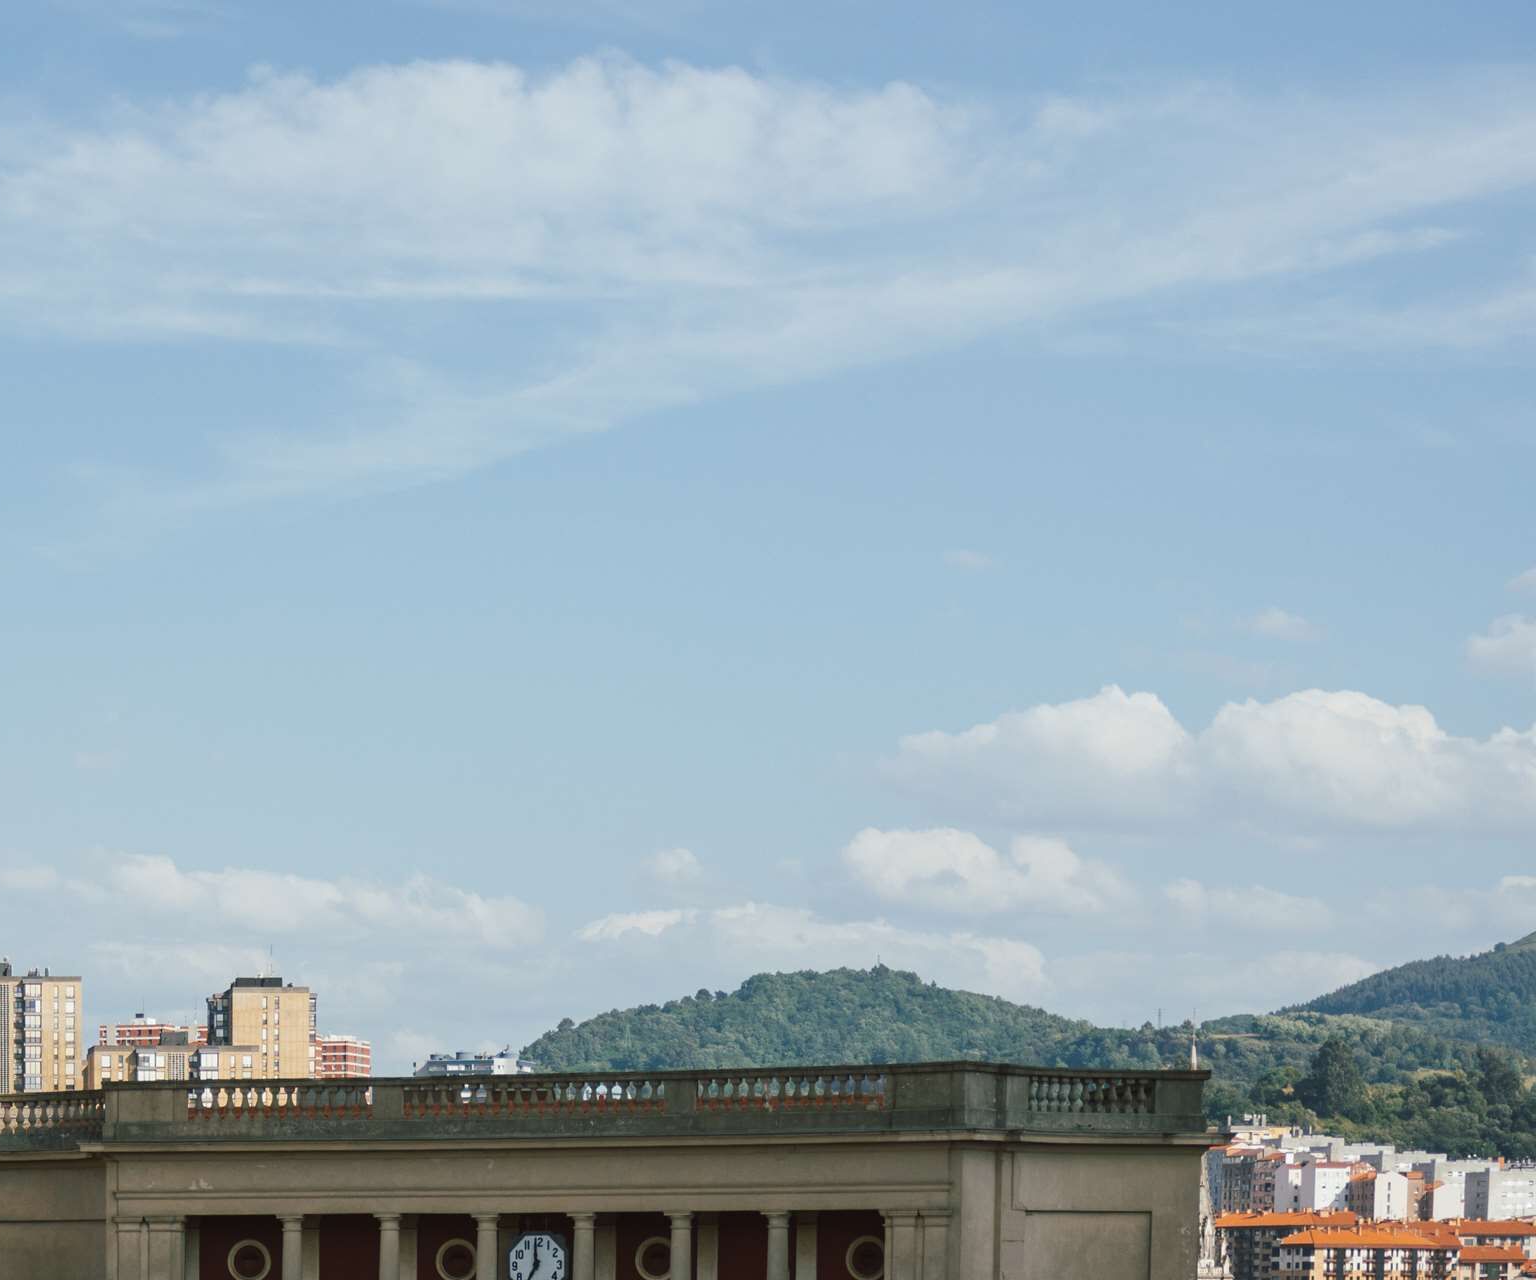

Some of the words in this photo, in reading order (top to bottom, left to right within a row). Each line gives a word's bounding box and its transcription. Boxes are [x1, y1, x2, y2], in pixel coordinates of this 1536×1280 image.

[524, 1239, 530, 1250] 11
[515, 1249, 524, 1260] 10
[552, 1247, 558, 1258] 2
[512, 1260, 518, 1271] 9
[556, 1260, 562, 1270] 3
[551, 1271, 557, 1280] 4
